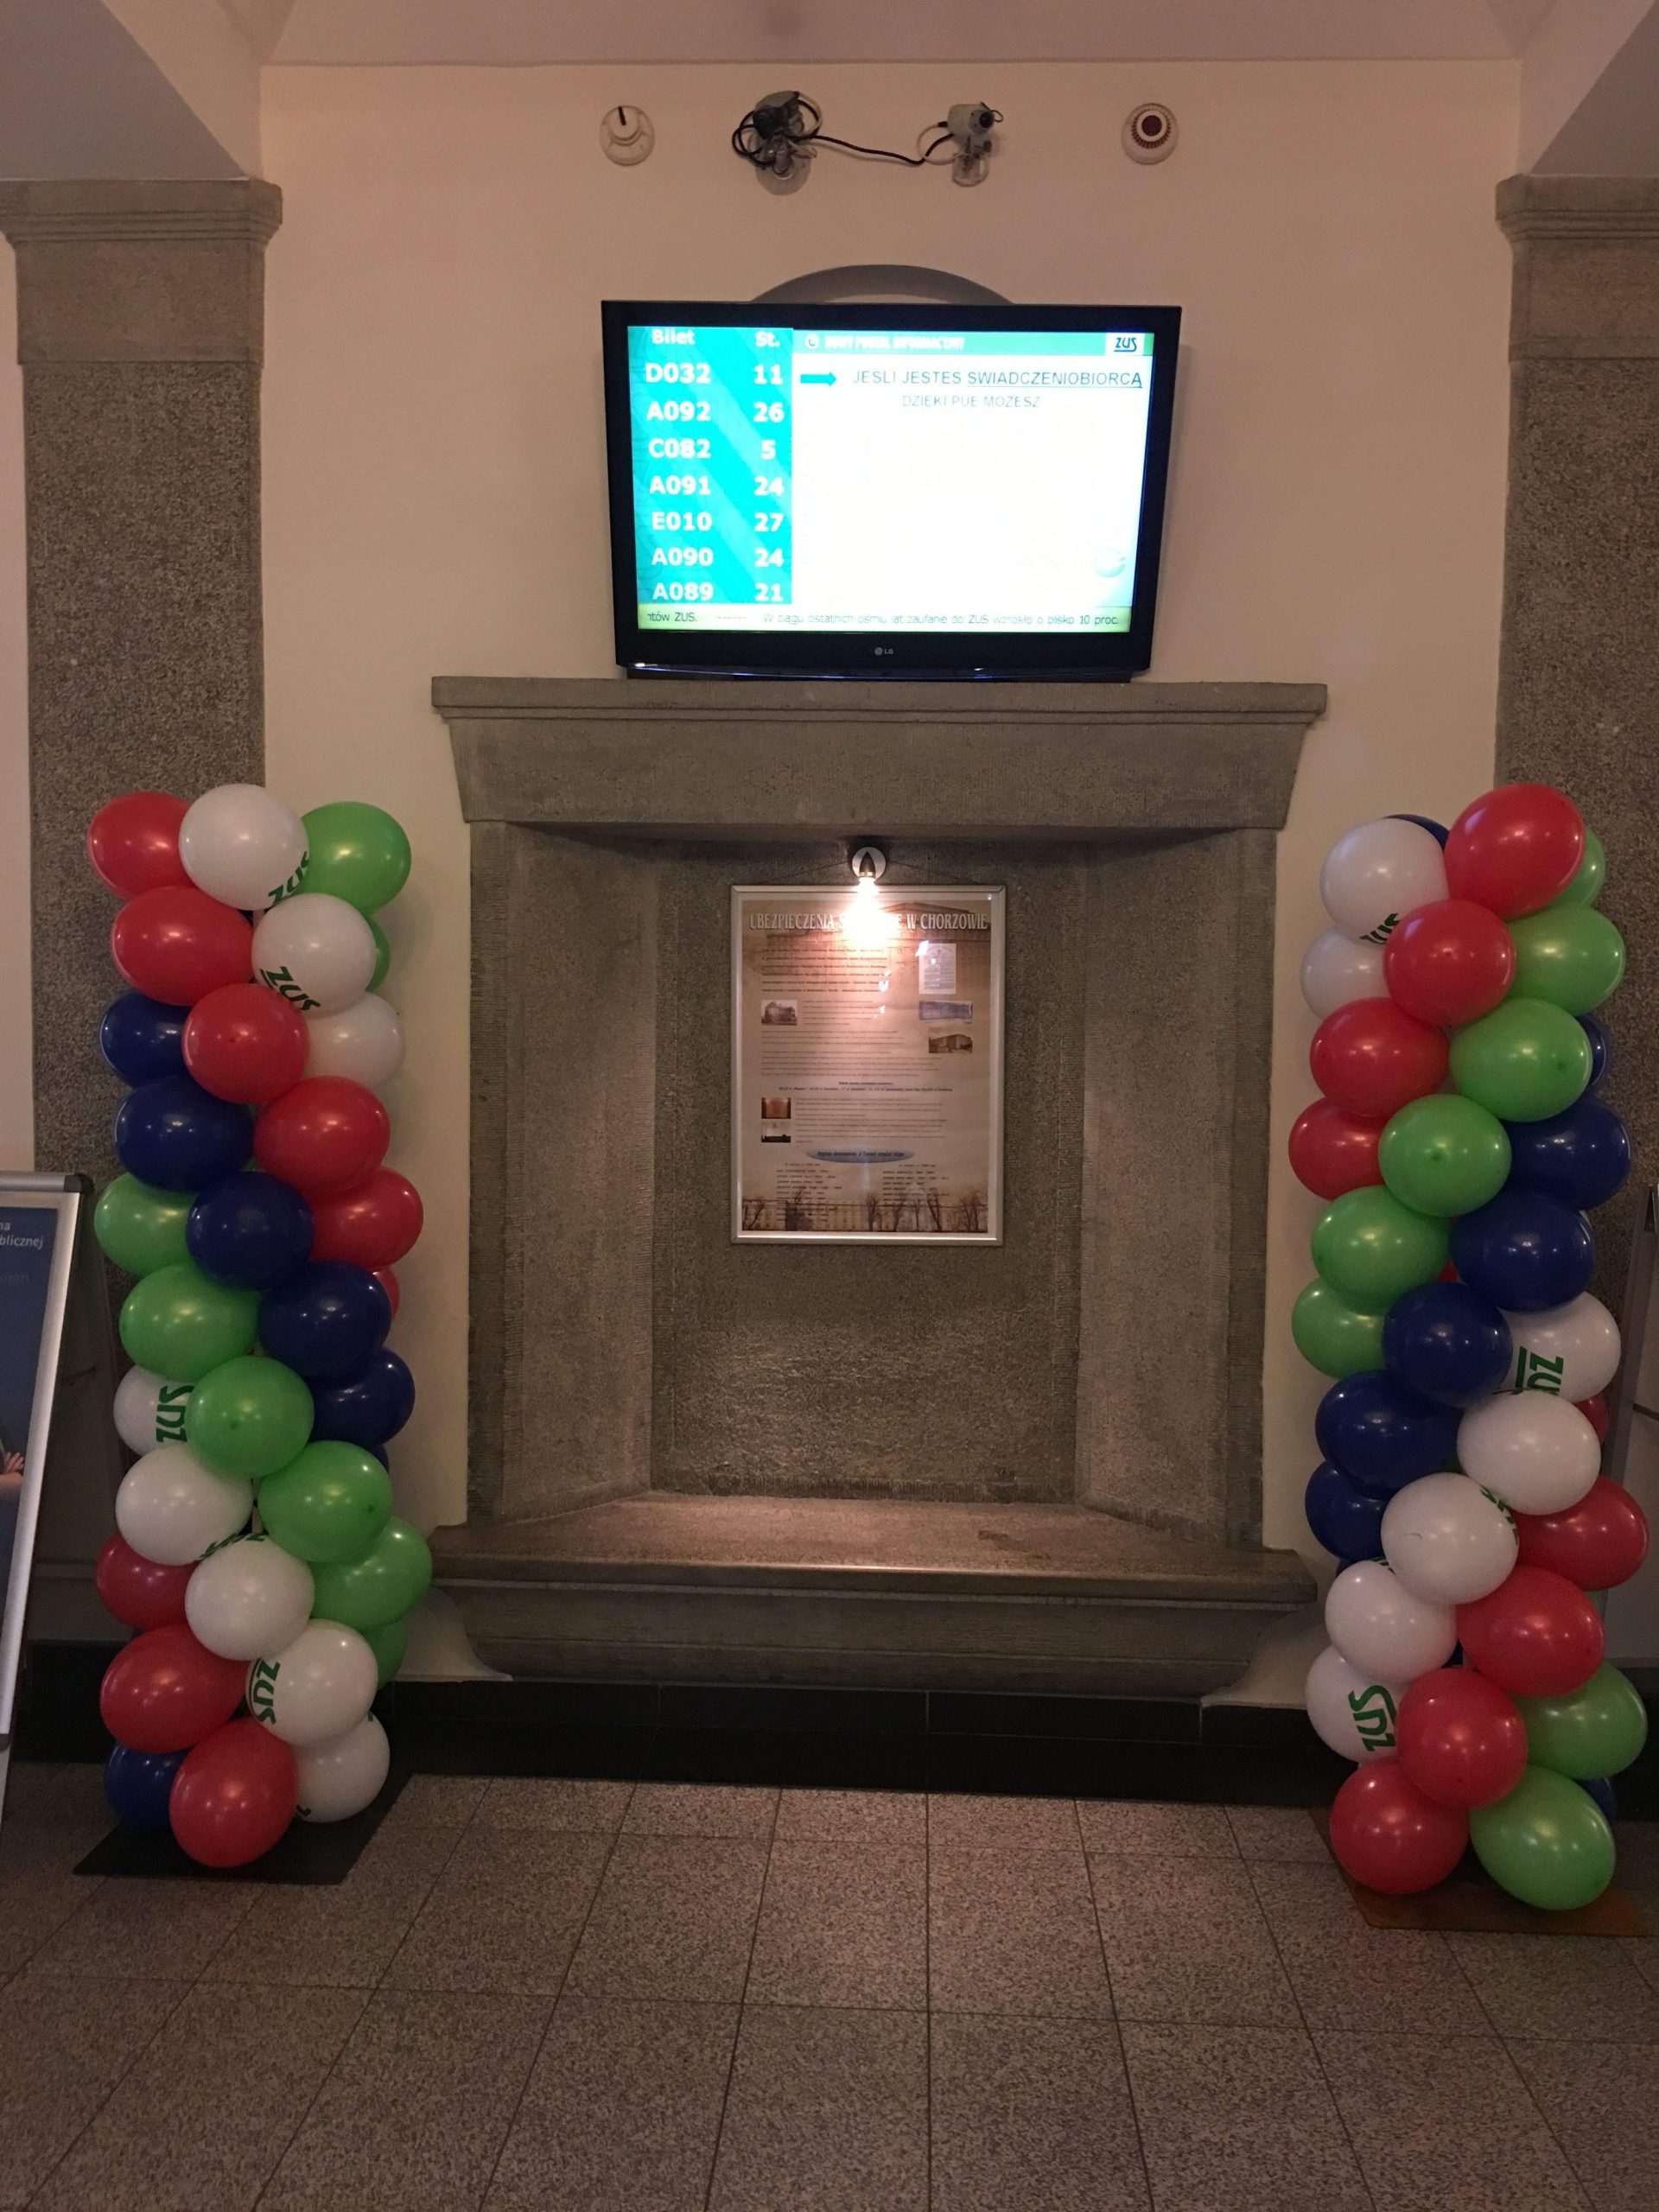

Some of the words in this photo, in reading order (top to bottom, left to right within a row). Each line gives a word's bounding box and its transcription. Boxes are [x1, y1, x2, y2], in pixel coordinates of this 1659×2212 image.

[652, 328, 696, 346] Bilet
[754, 331, 781, 347] St.
[1113, 336, 1137, 353] ZUS
[645, 362, 712, 384] D032
[753, 364, 785, 385] 11
[646, 400, 712, 422] A092
[753, 402, 785, 423] 26
[951, 395, 978, 408] PUE
[648, 438, 712, 459] C082
[760, 440, 777, 461] 5
[649, 475, 712, 496] A091
[753, 476, 785, 497] 24
[651, 512, 713, 531] E010
[753, 512, 785, 532] 27
[651, 547, 714, 566] A090
[754, 548, 785, 568] 24
[652, 582, 715, 601] A089
[754, 583, 784, 602] 21
[762, 613, 773, 623] W
[968, 614, 989, 625] ZUS
[1079, 615, 1091, 626] 10
[749, 912, 835, 931] UBEZPIECZENIA
[906, 912, 917, 930] W
[919, 912, 988, 931] CHORZOWIE
[1347, 1685, 1398, 1752] ZUS
